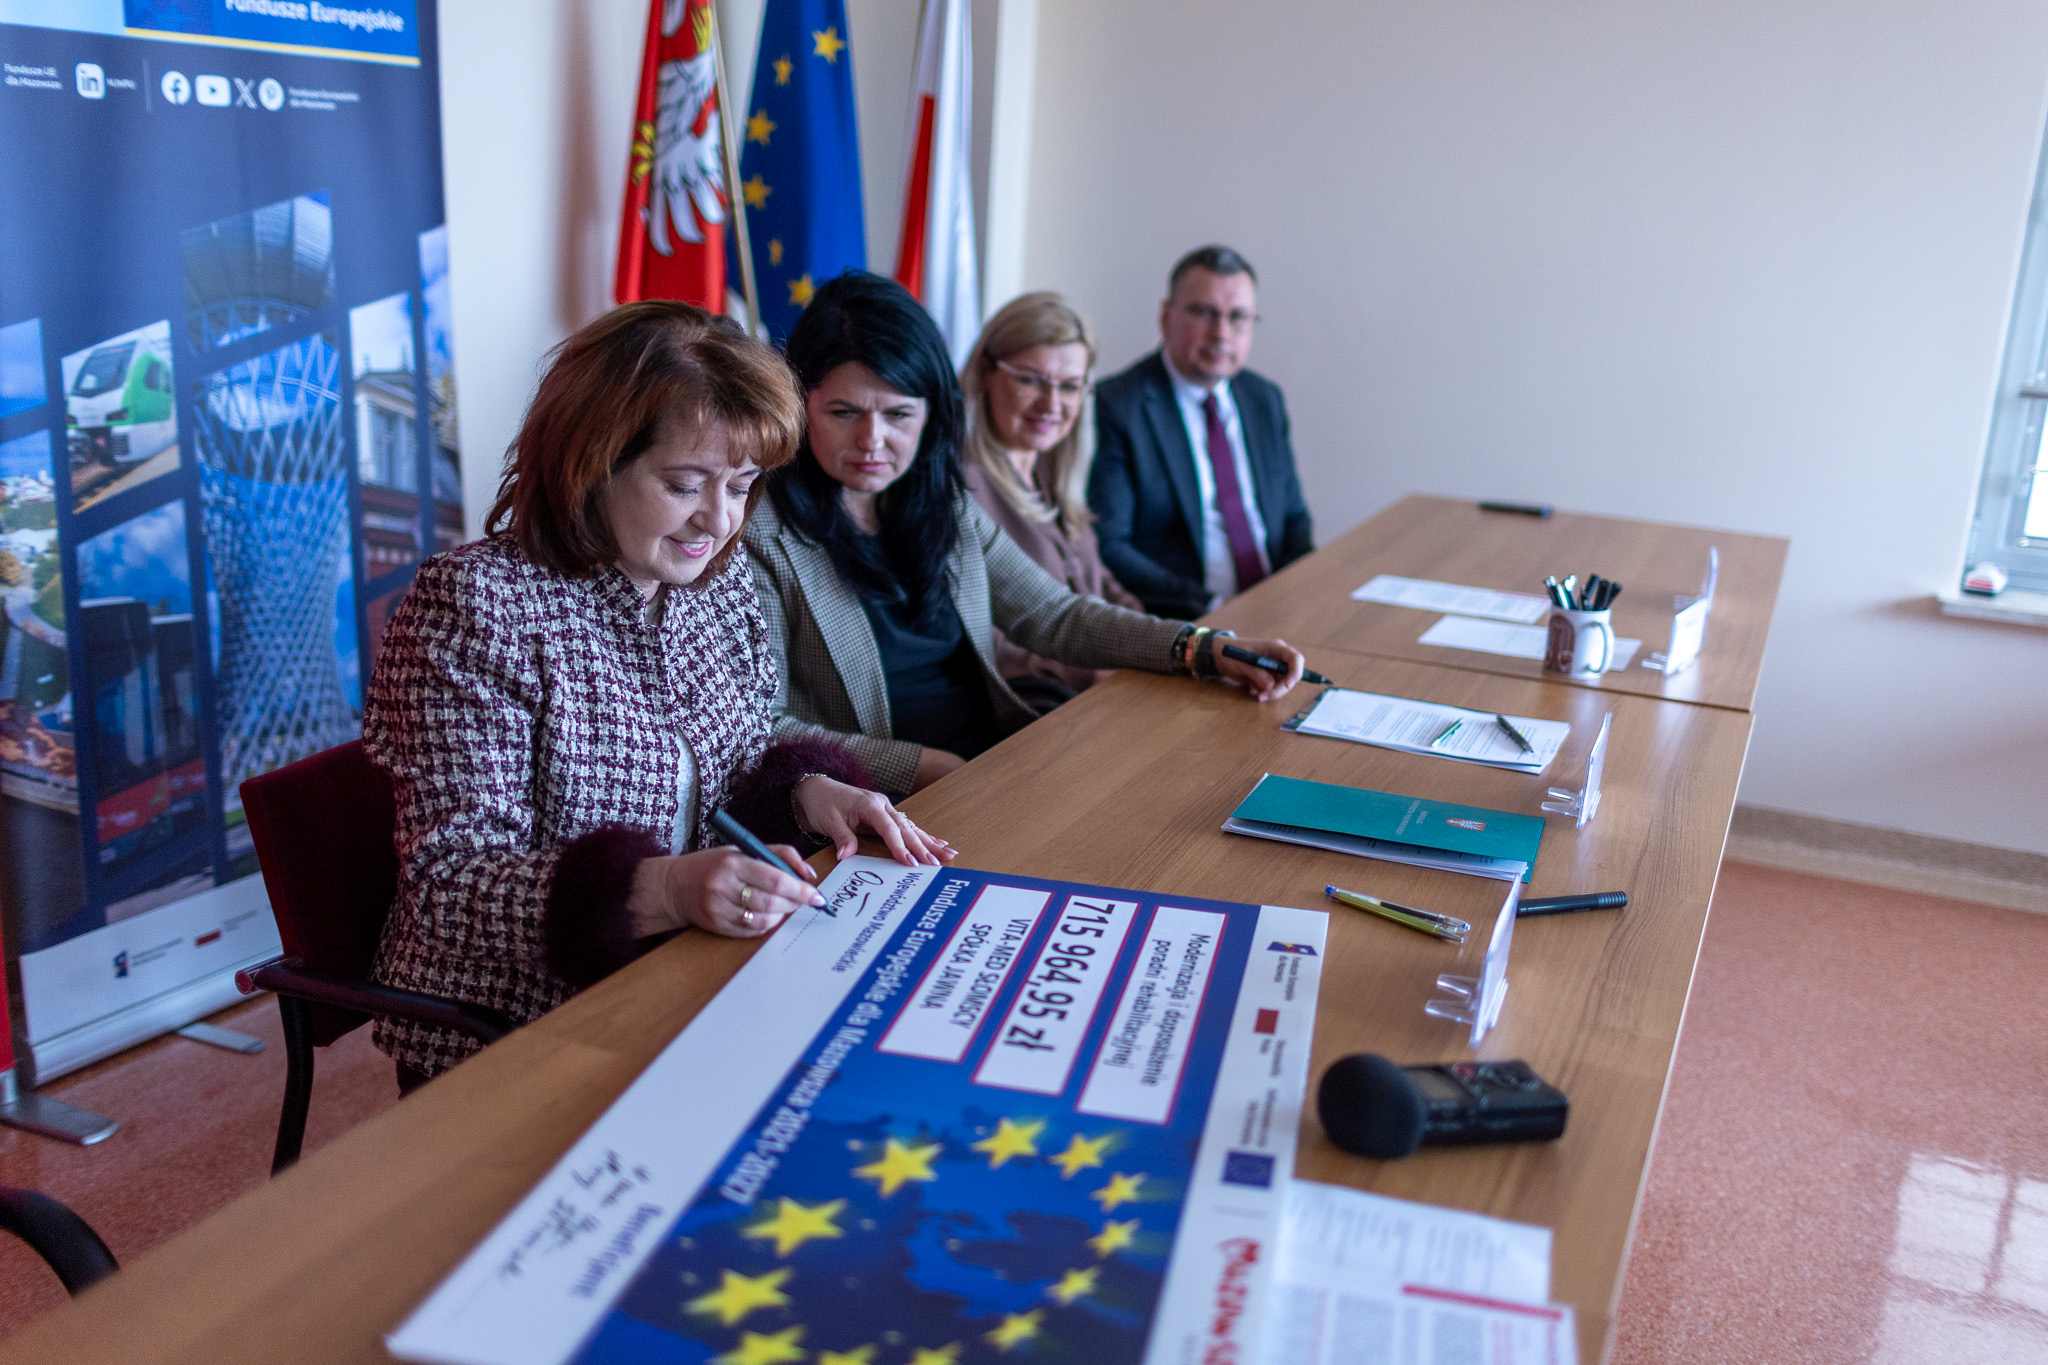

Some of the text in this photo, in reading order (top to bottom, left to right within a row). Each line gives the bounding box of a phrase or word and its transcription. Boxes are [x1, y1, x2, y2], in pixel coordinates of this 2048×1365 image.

[310, 1, 404, 33] Europejskie
[872, 872, 923, 922] Województwo
[917, 879, 970, 929] Fundusze
[832, 920, 884, 974] Mazowieckie
[865, 930, 936, 1002] Europejskie
[920, 923, 992, 1009] SPÓŁKA JAWNA
[985, 919, 1032, 970] VITA-MED
[1004, 901, 1115, 1051] 715 964,95 zł
[1166, 933, 1211, 1000] Modernizacja
[847, 1001, 883, 1026] dla
[1104, 938, 1172, 1069] poradni rehabilitacyjnej
[788, 1025, 868, 1107] Mazowsza
[1141, 1008, 1185, 1086] doposażenie
